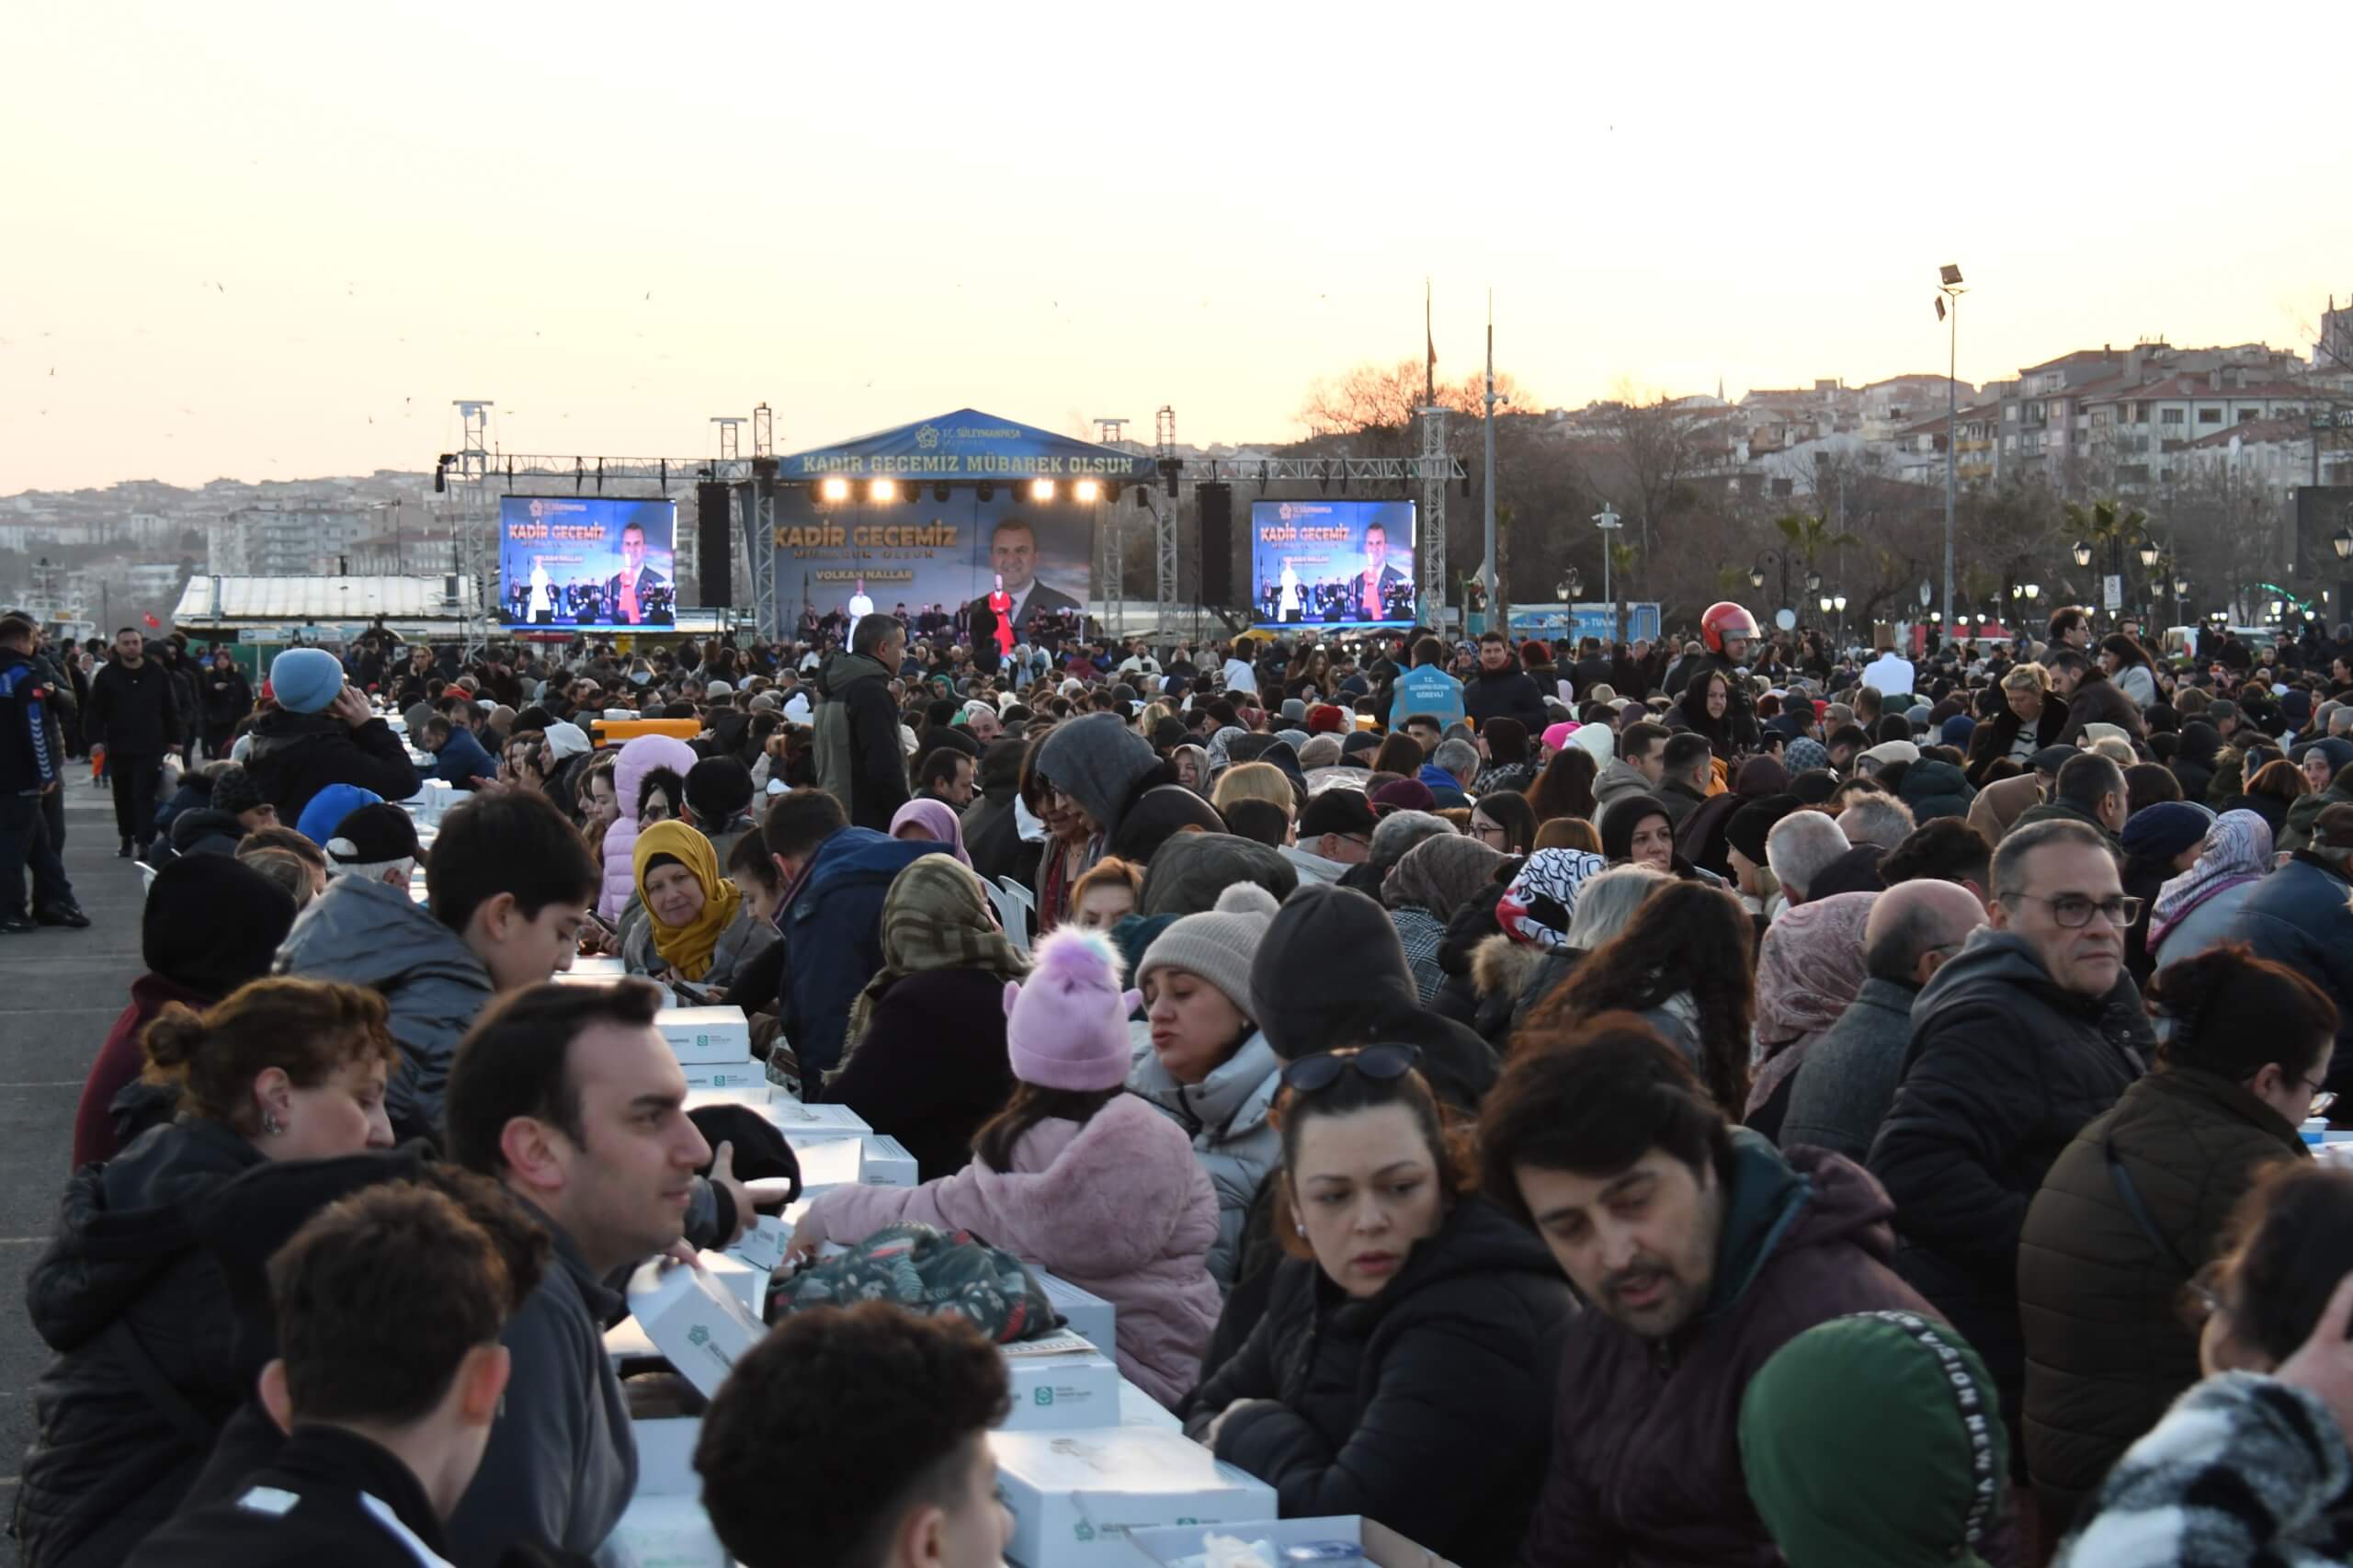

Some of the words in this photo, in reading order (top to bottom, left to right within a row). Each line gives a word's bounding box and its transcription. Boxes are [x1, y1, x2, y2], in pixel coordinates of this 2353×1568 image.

[803, 451, 864, 473] KADİR
[870, 451, 960, 473] GECEMİZ
[966, 451, 1063, 473] MÜBAREK
[1070, 458, 1133, 473] OLSUN
[510, 519, 549, 540] KADİR
[775, 518, 846, 548] KADİR
[852, 519, 958, 548] GECEMİZ
[1261, 522, 1297, 541] KADİR
